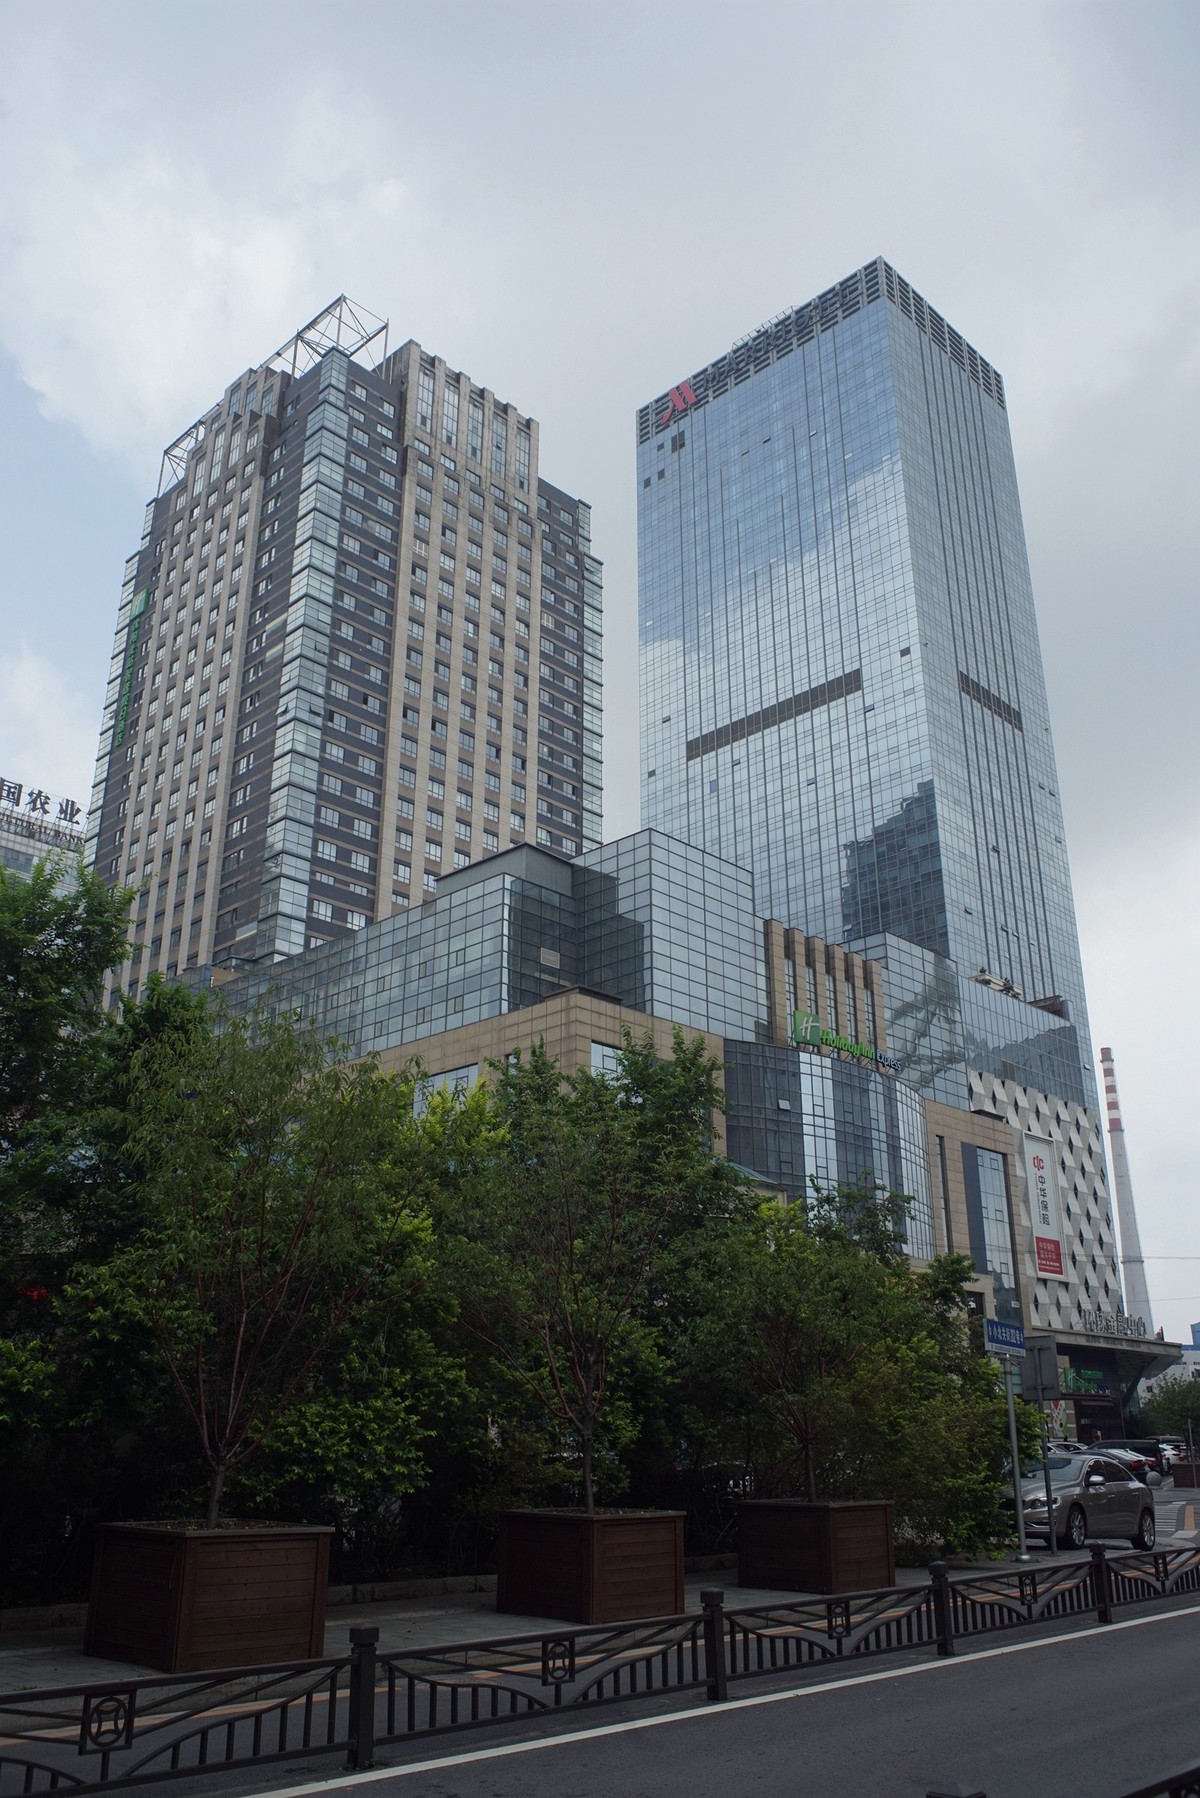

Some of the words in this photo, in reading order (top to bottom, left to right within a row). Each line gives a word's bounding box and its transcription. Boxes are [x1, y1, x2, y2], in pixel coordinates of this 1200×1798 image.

[703, 284, 850, 391] MARRIOTT
[0, 777, 81, 825] 国农业
[821, 1029, 860, 1057] Holiday
[861, 1041, 875, 1060] Inn
[876, 1049, 901, 1071] Express
